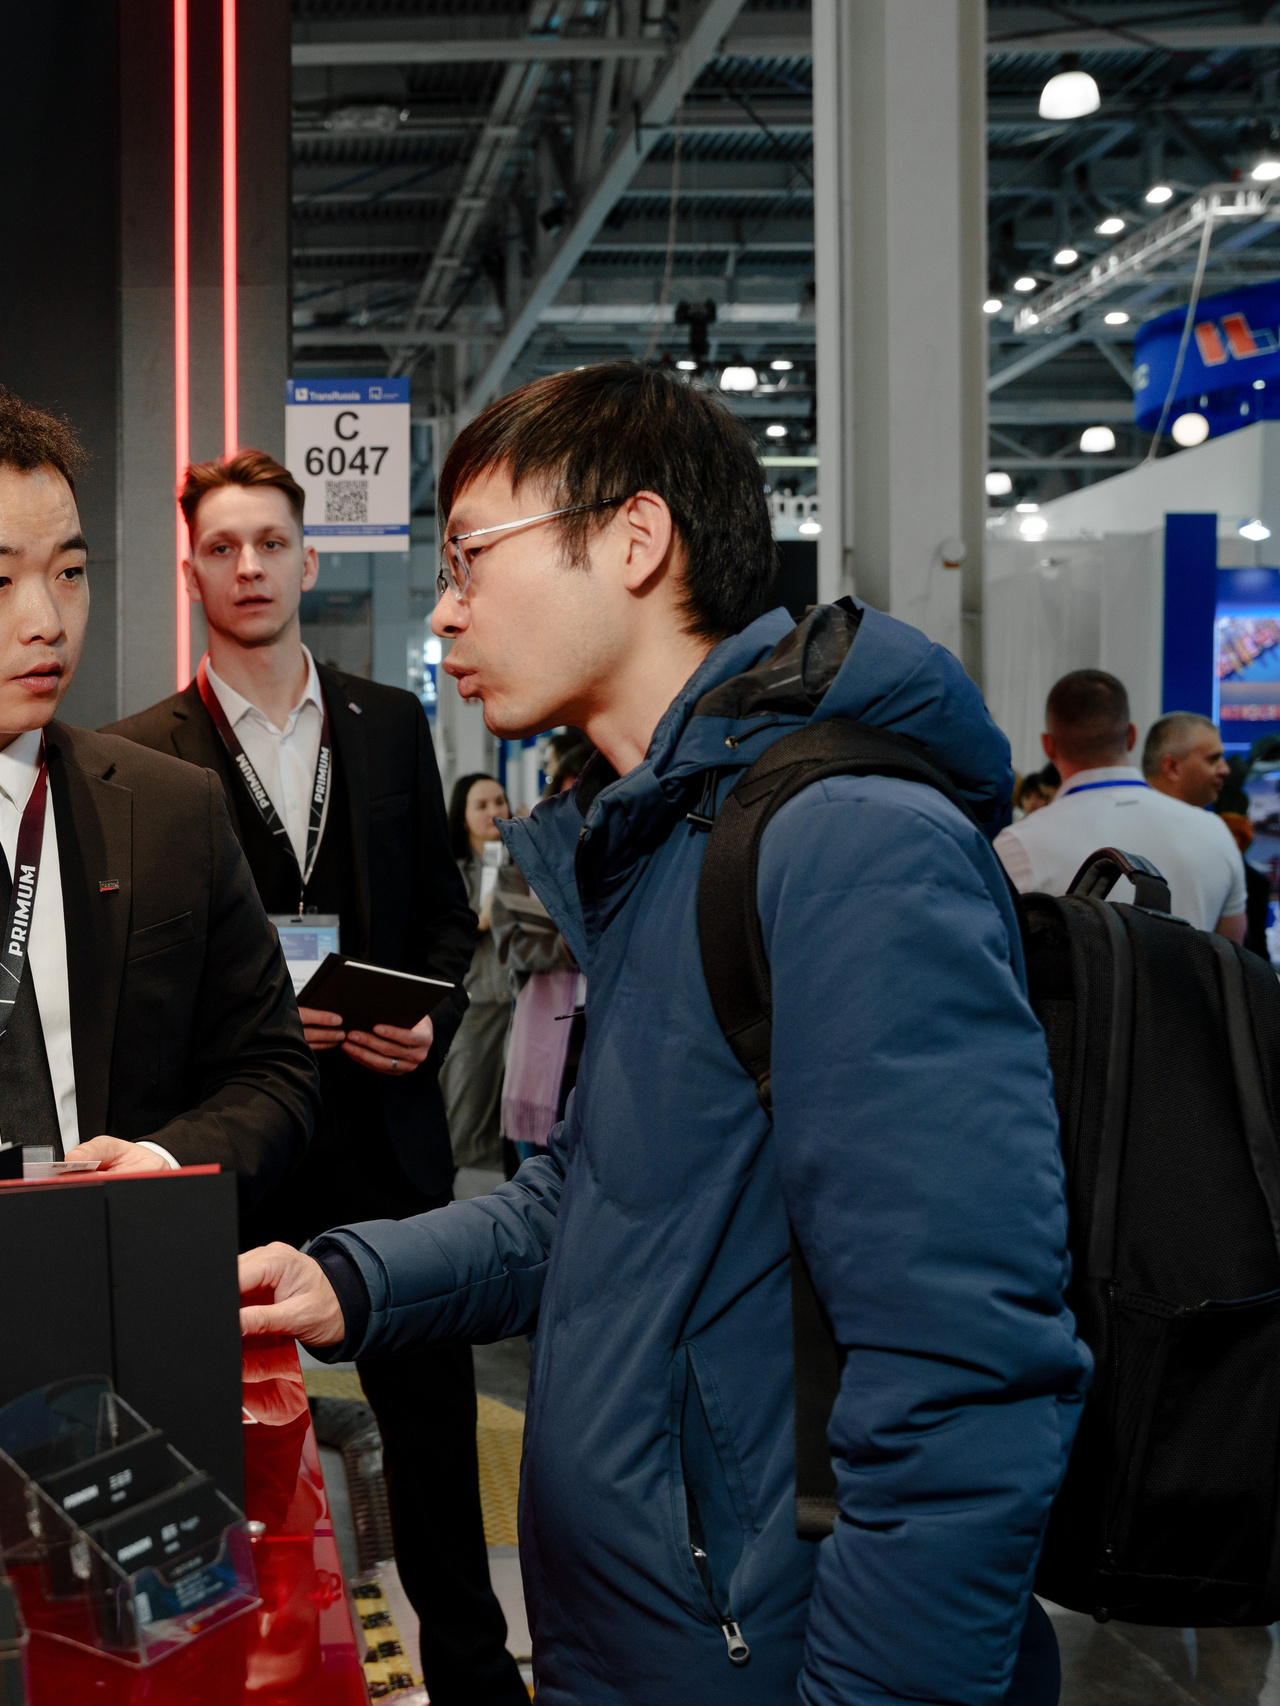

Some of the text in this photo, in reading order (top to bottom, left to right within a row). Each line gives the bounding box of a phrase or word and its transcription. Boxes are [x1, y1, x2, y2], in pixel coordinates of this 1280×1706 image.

[309, 391, 361, 402] TransRussia
[334, 411, 360, 441] C
[305, 446, 389, 476] 6047
[235, 753, 271, 809] PRIMUM
[313, 746, 331, 804] PRIMUM
[8, 864, 37, 957] PRIMUM
